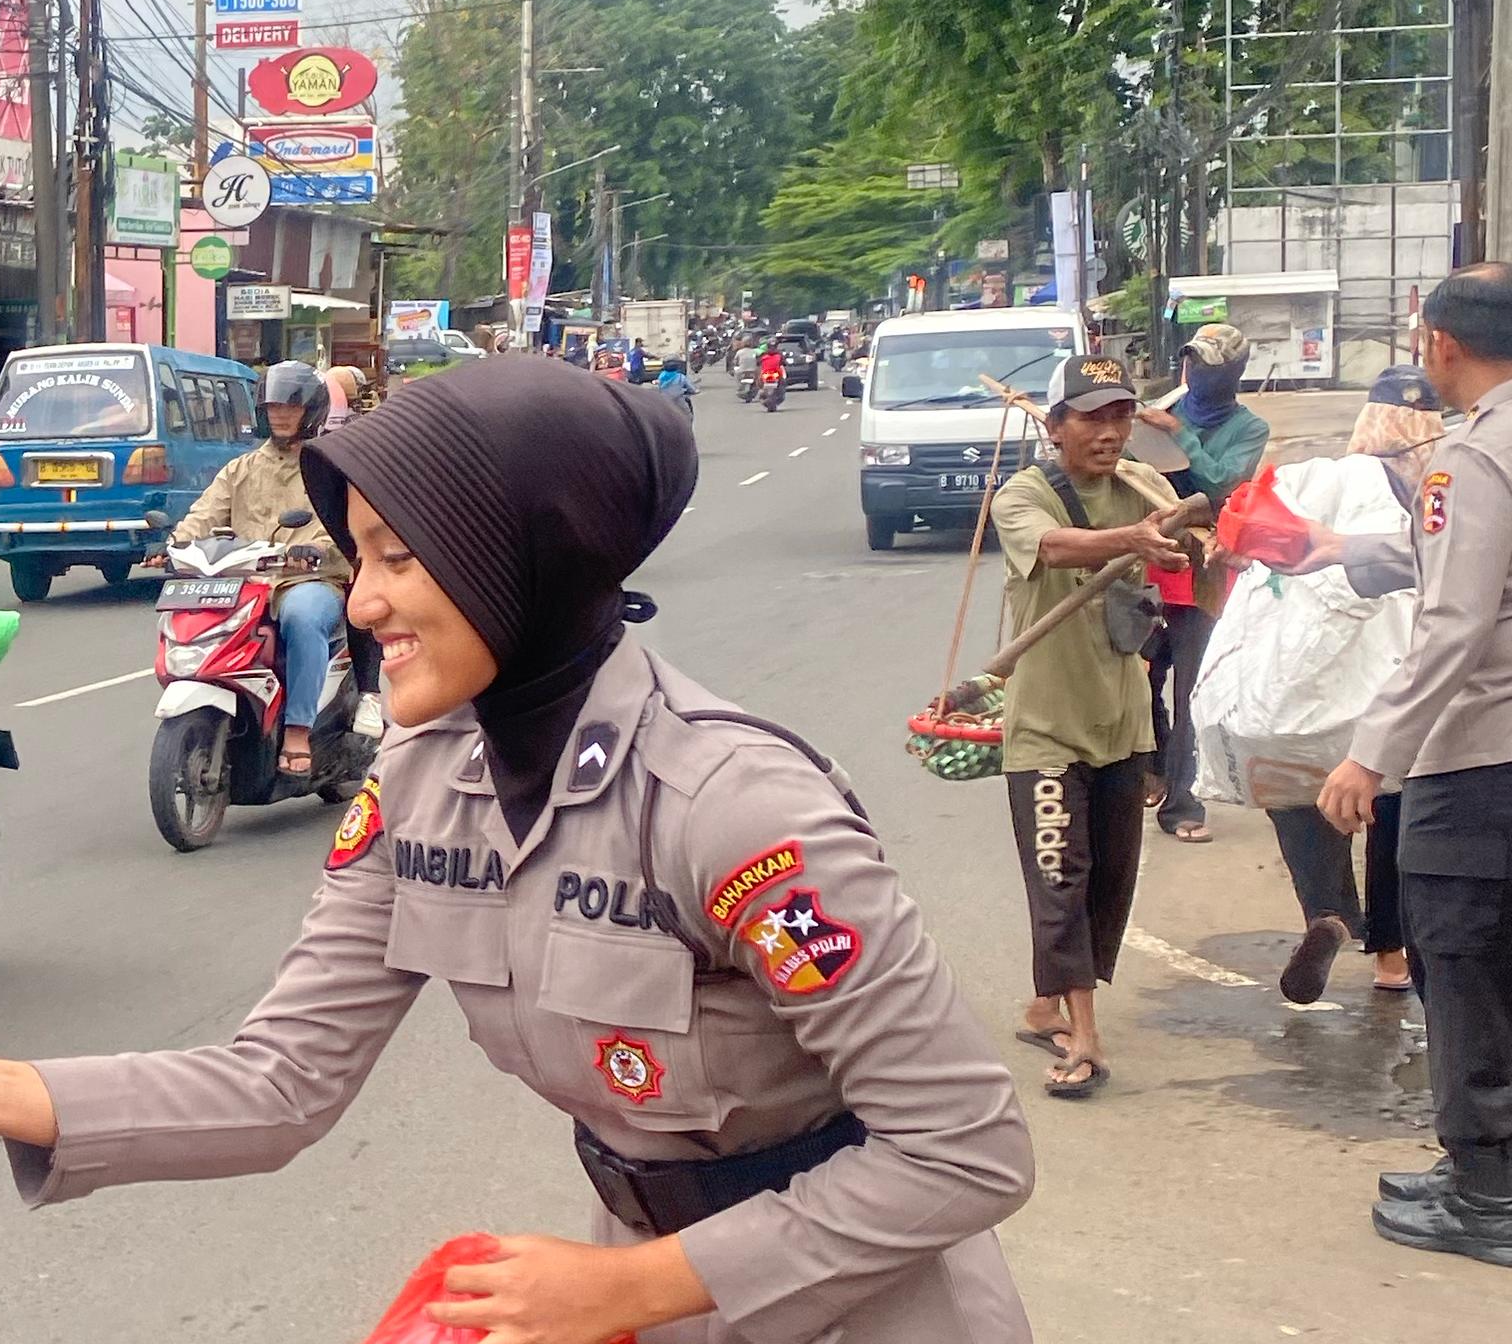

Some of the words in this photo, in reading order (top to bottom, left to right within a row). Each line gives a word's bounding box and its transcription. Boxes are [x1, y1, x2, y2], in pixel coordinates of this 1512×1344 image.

[222, 26, 292, 44] DELIVERY
[292, 79, 337, 91] YAMAN
[274, 139, 351, 157] Indomaret
[6, 376, 56, 418] MURANG
[101, 378, 136, 414] SUNDA
[955, 474, 979, 487] 9710
[179, 583, 209, 596] 3949
[395, 839, 504, 891] NABILA
[712, 850, 797, 920] BAHARKAM
[809, 934, 852, 958] POLRI
